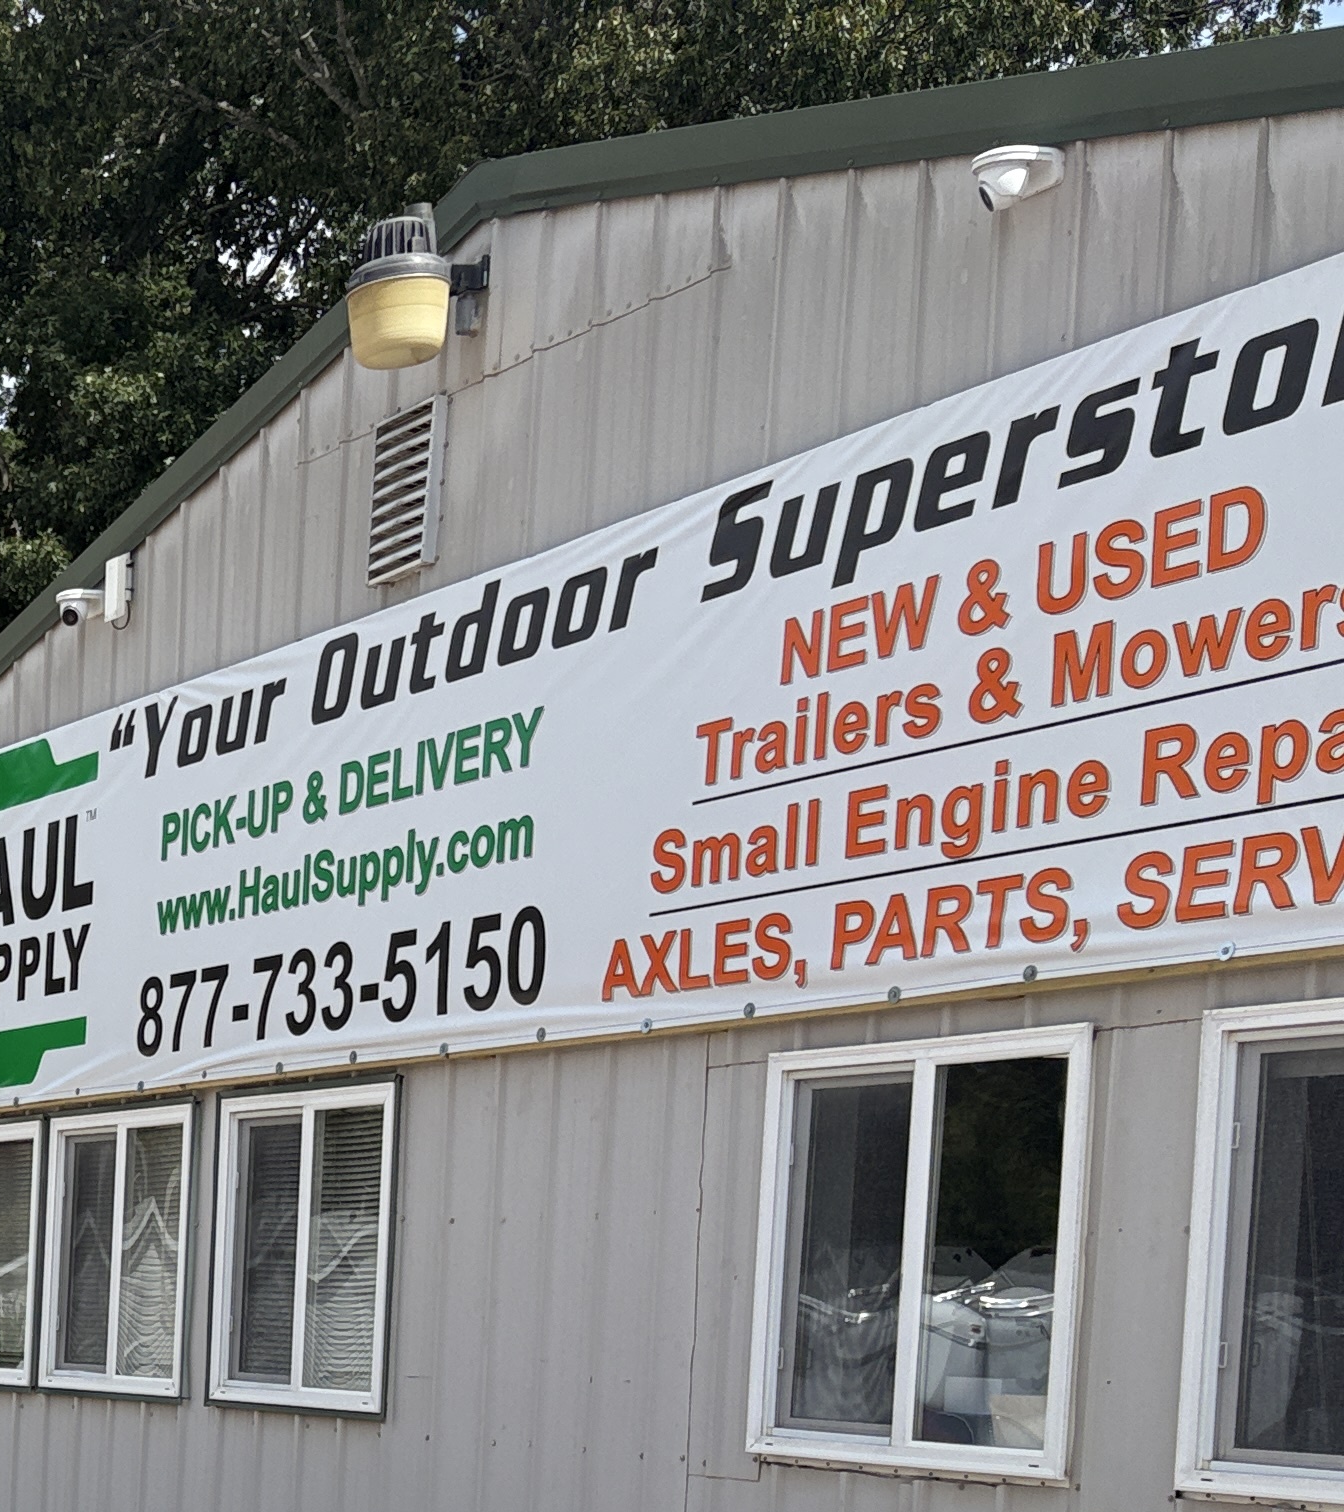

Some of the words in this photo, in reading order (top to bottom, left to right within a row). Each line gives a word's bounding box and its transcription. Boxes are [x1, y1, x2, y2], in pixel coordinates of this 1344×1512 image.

[312, 546, 659, 725] Outdoor
[780, 575, 942, 685] NEW
[958, 559, 1012, 637] &
[1037, 486, 1268, 616] USED
[697, 681, 943, 786] Trailers
[968, 648, 1022, 725] &
[1051, 584, 1344, 707] Mower
[161, 780, 293, 862] PICK-UP
[303, 770, 328, 824] &
[339, 706, 545, 815] DELIVERY
[651, 803, 821, 895] Small
[845, 759, 1111, 860] Engine
[157, 814, 534, 935] www.HaulSupply.com
[601, 912, 808, 1002] AXLES,
[830, 867, 1090, 970] PARTS,
[137, 906, 546, 1056] 877-733-5150
